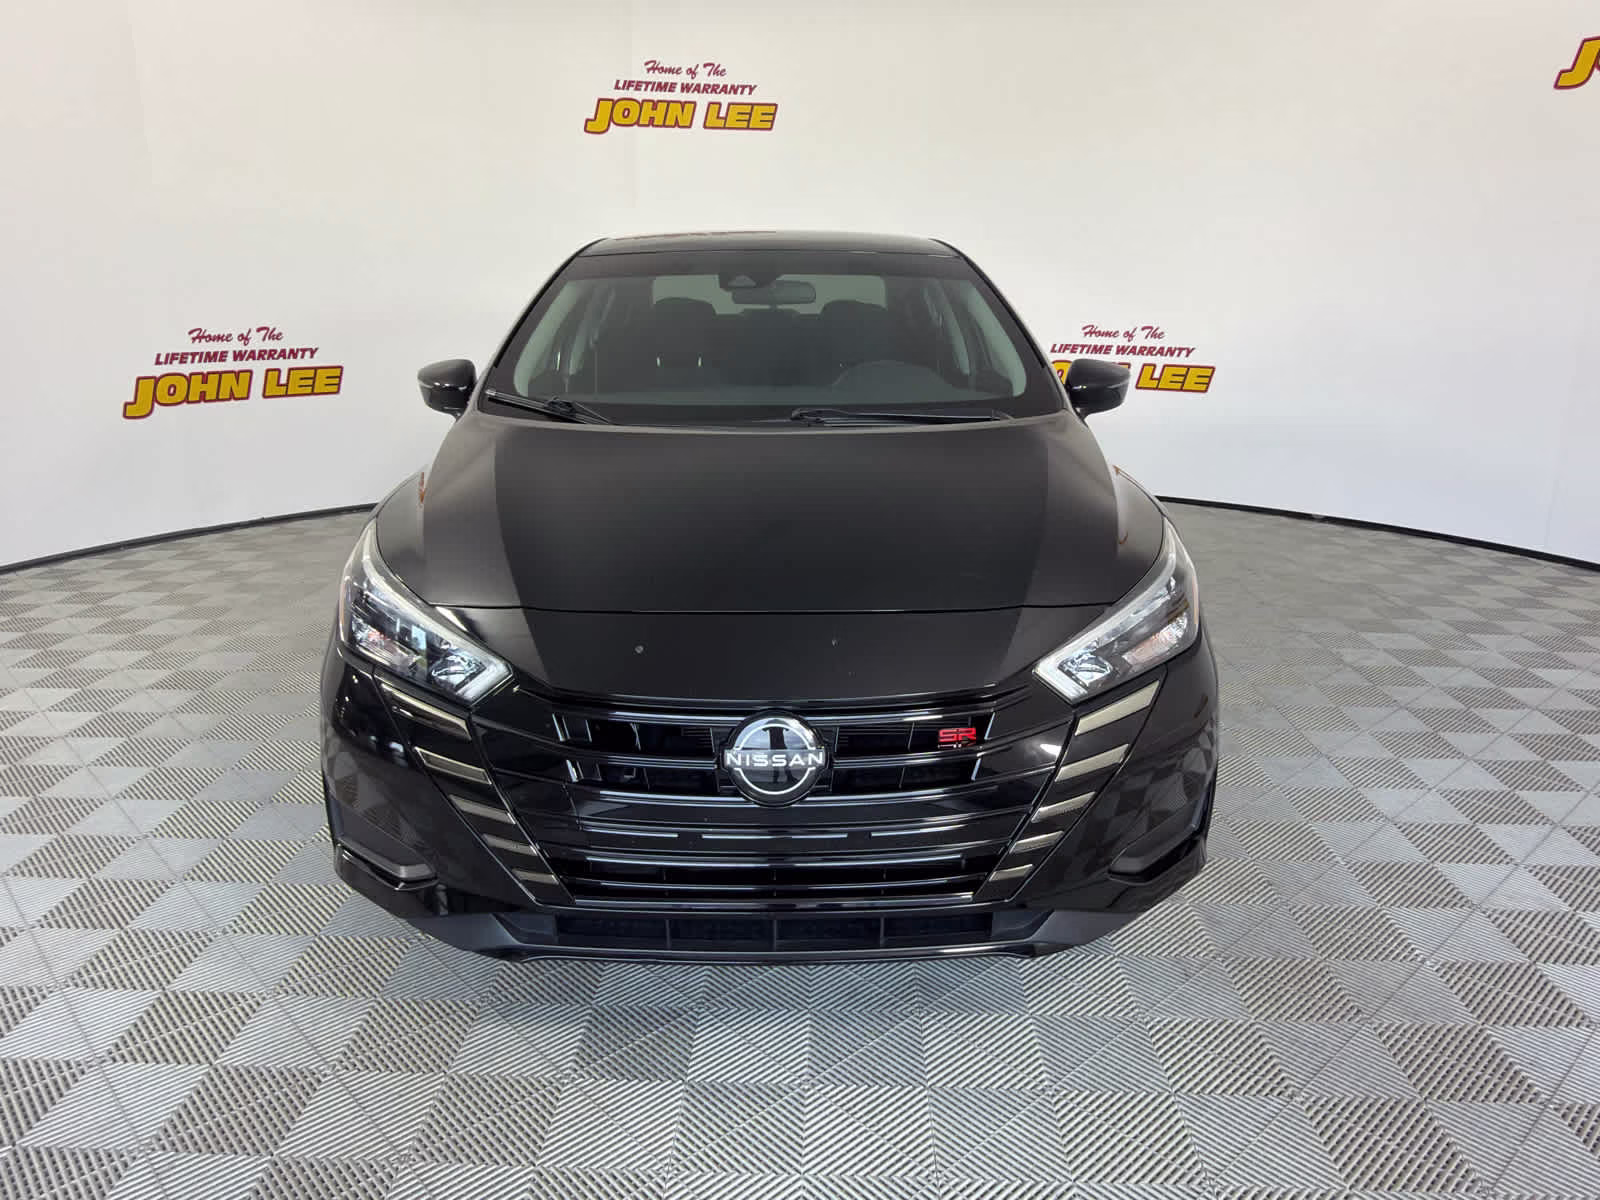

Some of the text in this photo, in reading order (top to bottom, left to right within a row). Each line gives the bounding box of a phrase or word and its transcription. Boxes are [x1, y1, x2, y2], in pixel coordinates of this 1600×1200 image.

[644, 60, 727, 79] Home of The
[614, 79, 757, 96] LIFETIME WARRANTY
[584, 98, 778, 134] JOHN LEE
[188, 326, 284, 346] Home of The
[1082, 325, 1165, 342] Home of The
[154, 347, 319, 366] LIFETIME WARRANTY
[1050, 343, 1195, 358] LIFETIME WARRANTY
[1135, 363, 1216, 393] LEE
[123, 366, 344, 420] JOHN LEE
[938, 727, 977, 743] SR
[725, 751, 824, 768] NISSAN
